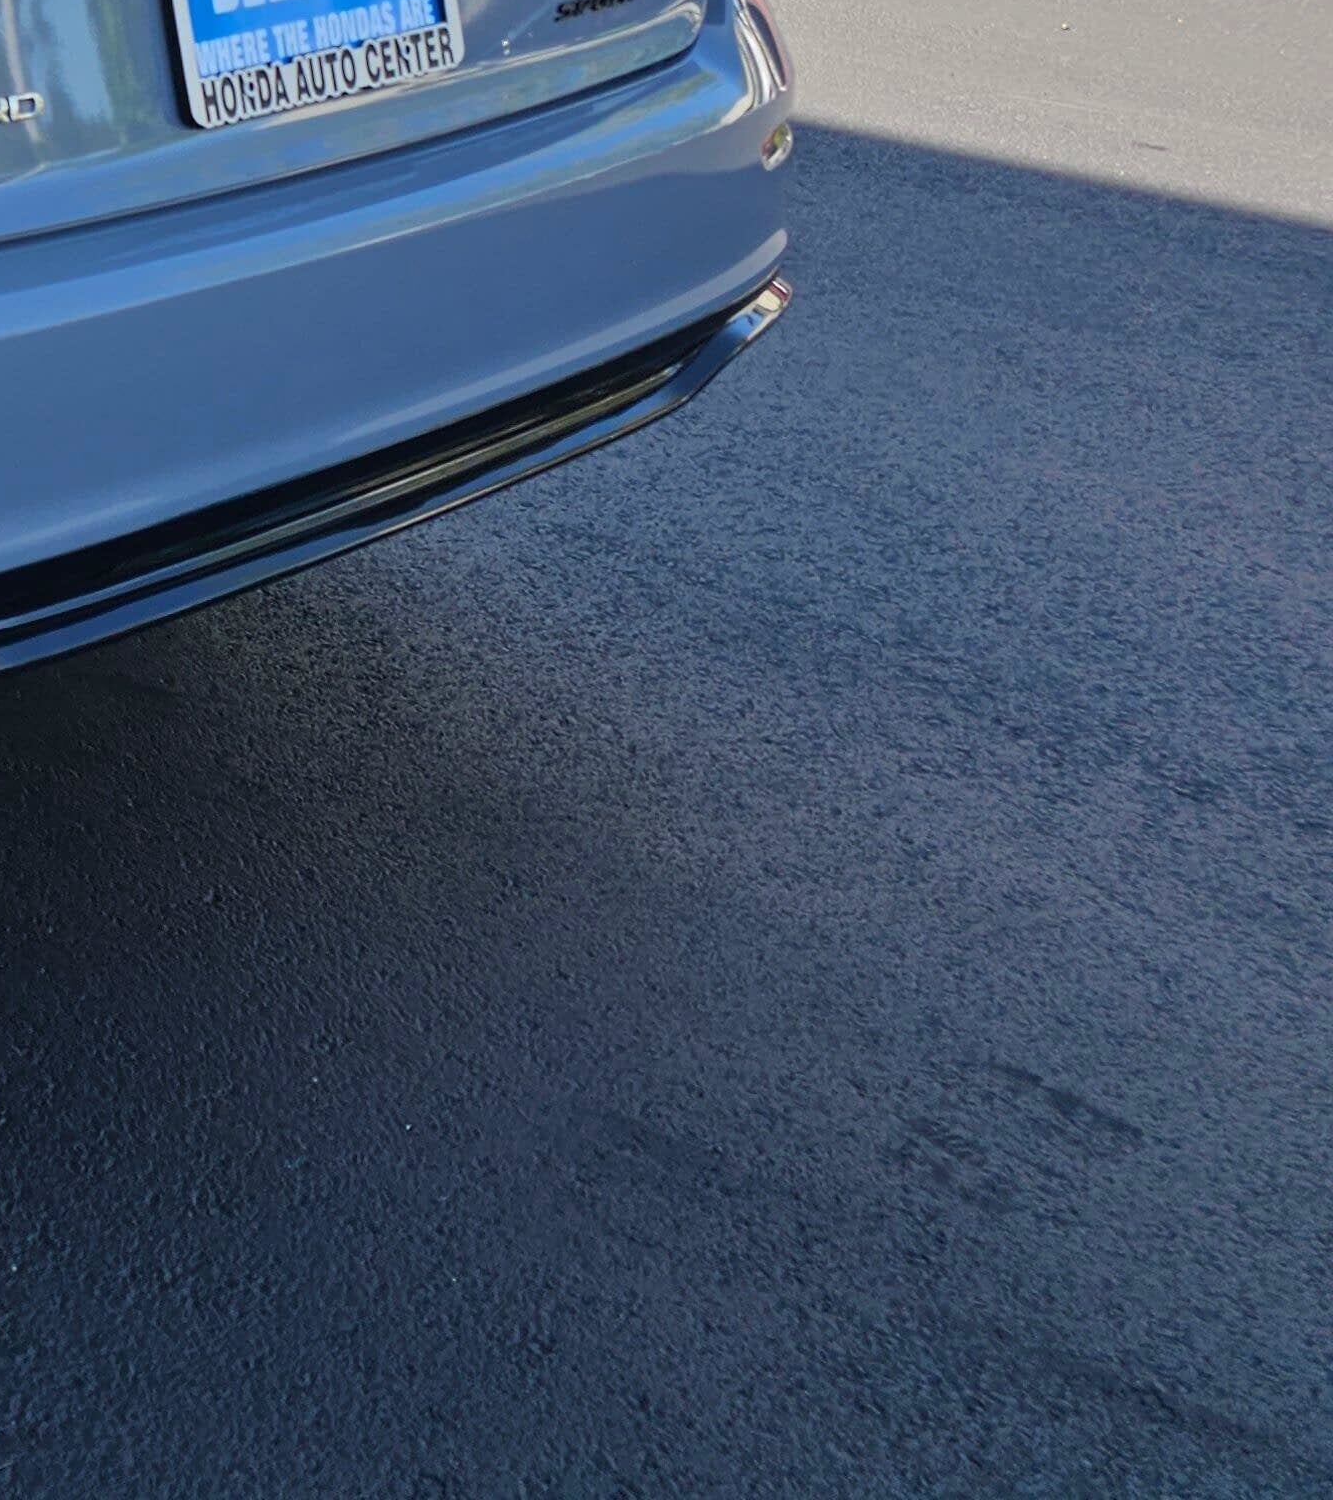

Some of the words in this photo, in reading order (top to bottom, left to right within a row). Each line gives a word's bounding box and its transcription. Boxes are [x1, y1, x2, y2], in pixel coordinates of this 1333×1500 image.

[193, 30, 271, 77] WHERE
[273, 20, 310, 58] THE
[313, 0, 396, 46] HONDAS
[199, 66, 290, 124] HONDA
[295, 47, 358, 105] AUTO
[365, 27, 455, 79] CENTER
